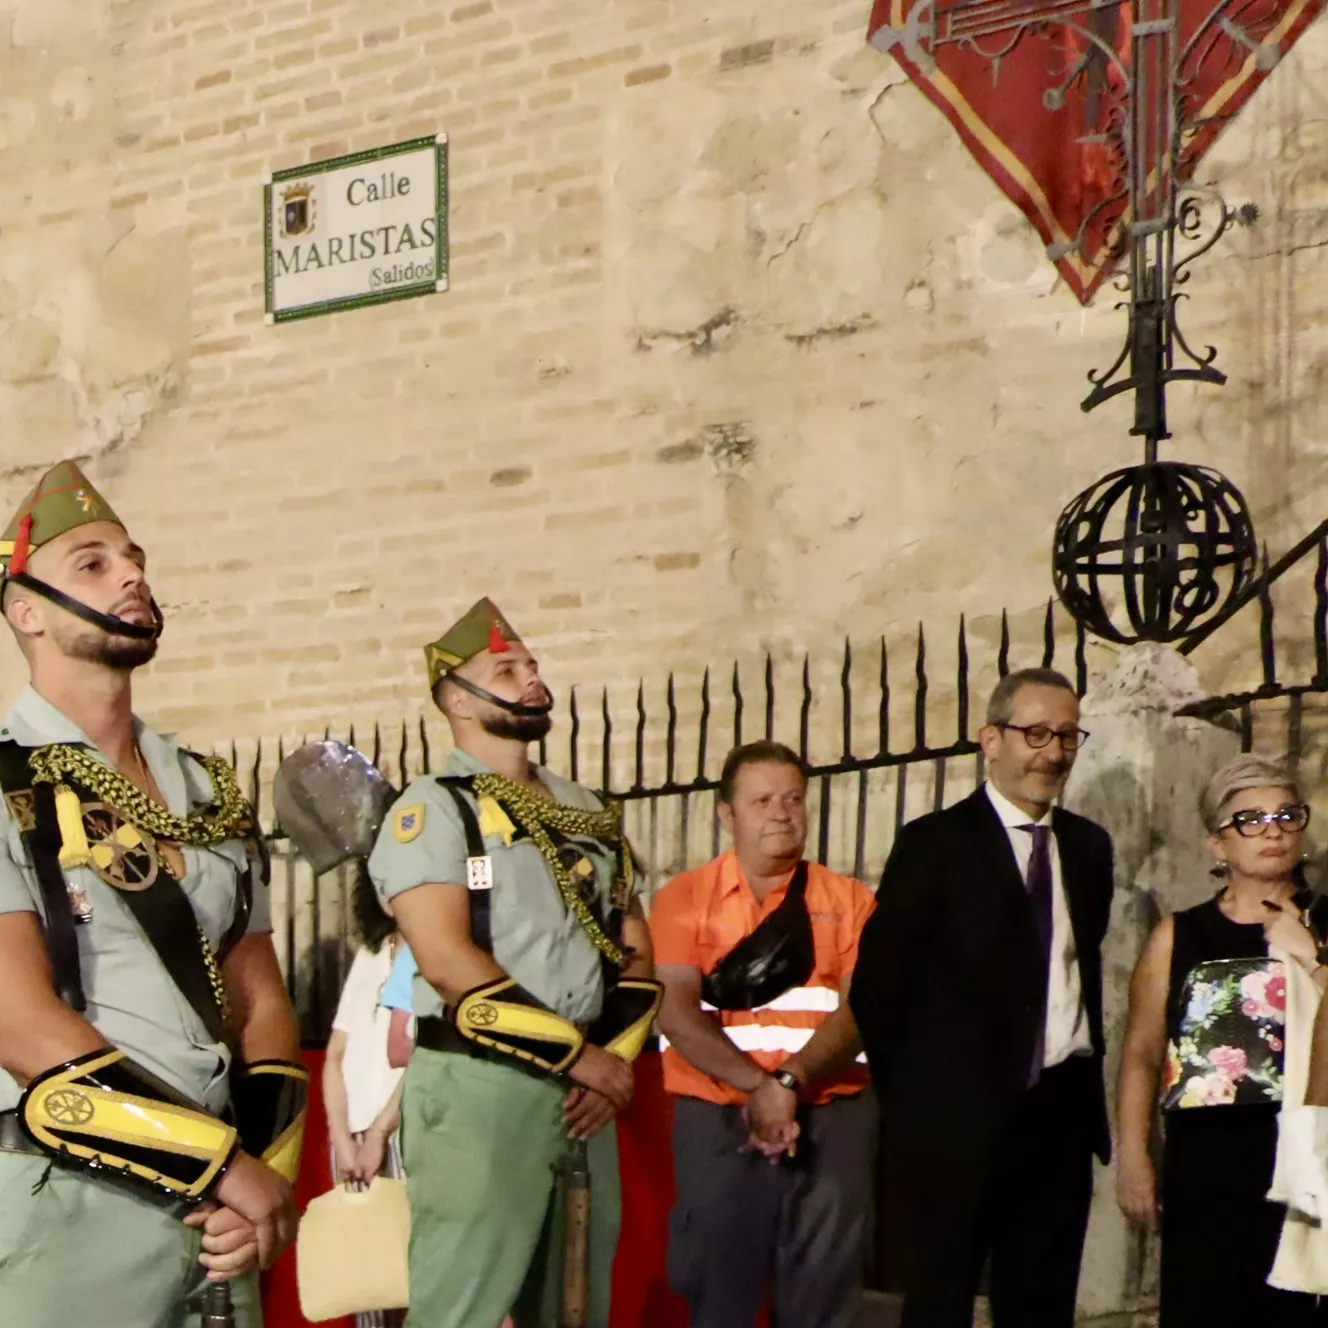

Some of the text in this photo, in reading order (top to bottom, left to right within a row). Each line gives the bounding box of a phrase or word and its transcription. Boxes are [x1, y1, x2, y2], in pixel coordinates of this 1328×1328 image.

[346, 173, 411, 207] Calle
[275, 217, 436, 278] MARISTAS
[371, 262, 434, 286] Salidos
